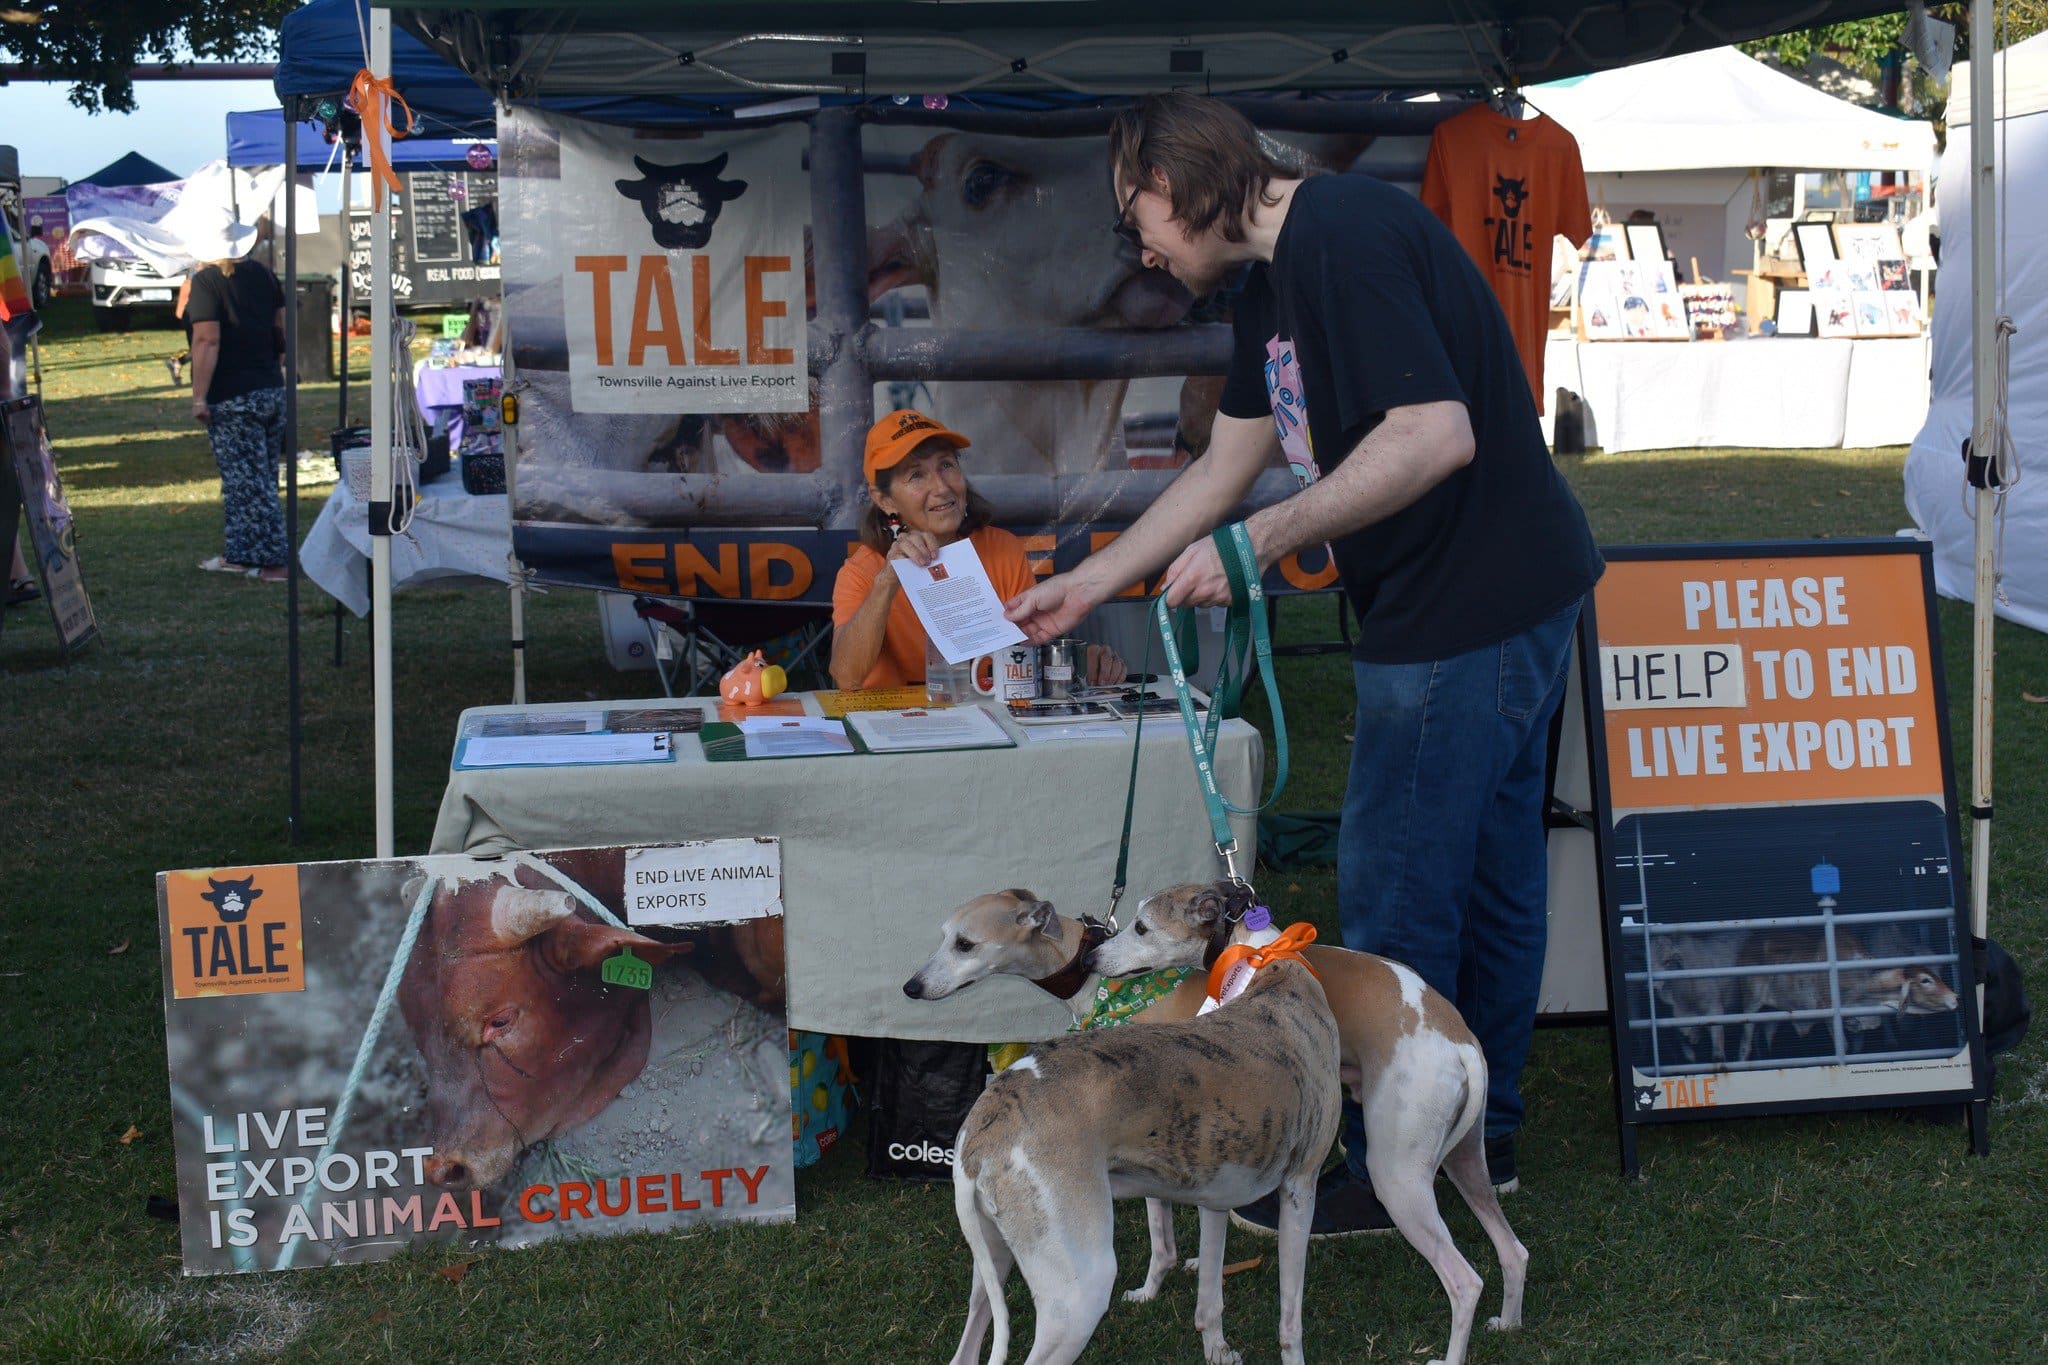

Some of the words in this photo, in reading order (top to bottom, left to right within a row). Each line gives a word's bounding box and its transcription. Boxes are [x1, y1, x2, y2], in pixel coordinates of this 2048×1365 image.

[426, 268, 450, 282] REAL
[451, 267, 475, 281] FOOD
[575, 255, 794, 366] TALE
[597, 375, 663, 388] Townsville
[667, 375, 716, 390] Against
[721, 375, 747, 388] Live
[751, 375, 796, 389] Export
[611, 542, 814, 600] END
[1682, 576, 1849, 631] PLEASE
[1005, 663, 1033, 679] TALE
[1611, 650, 1730, 702] HELP
[1753, 649, 1813, 699] TO
[1827, 645, 1917, 697] END
[1628, 725, 1728, 778] LIVE
[1739, 716, 1916, 774] EXPORT
[635, 869, 669, 886] END
[672, 867, 705, 885] LIVE
[708, 864, 775, 882] ANIMAL
[636, 892, 707, 911] EXPORTS
[182, 921, 289, 978] TALE
[194, 980, 227, 988] Townsville
[228, 979, 253, 987] Against
[268, 976, 290, 985] Export
[605, 964, 650, 986] 1735
[1660, 1076, 1718, 1110] TALE
[203, 1107, 329, 1155] LIVE
[888, 1140, 955, 1166] coles
[206, 1146, 435, 1203] EXPORT
[210, 1205, 260, 1249] IS
[278, 1190, 503, 1245] ANIMAL
[518, 1164, 771, 1225] CRUELTY
